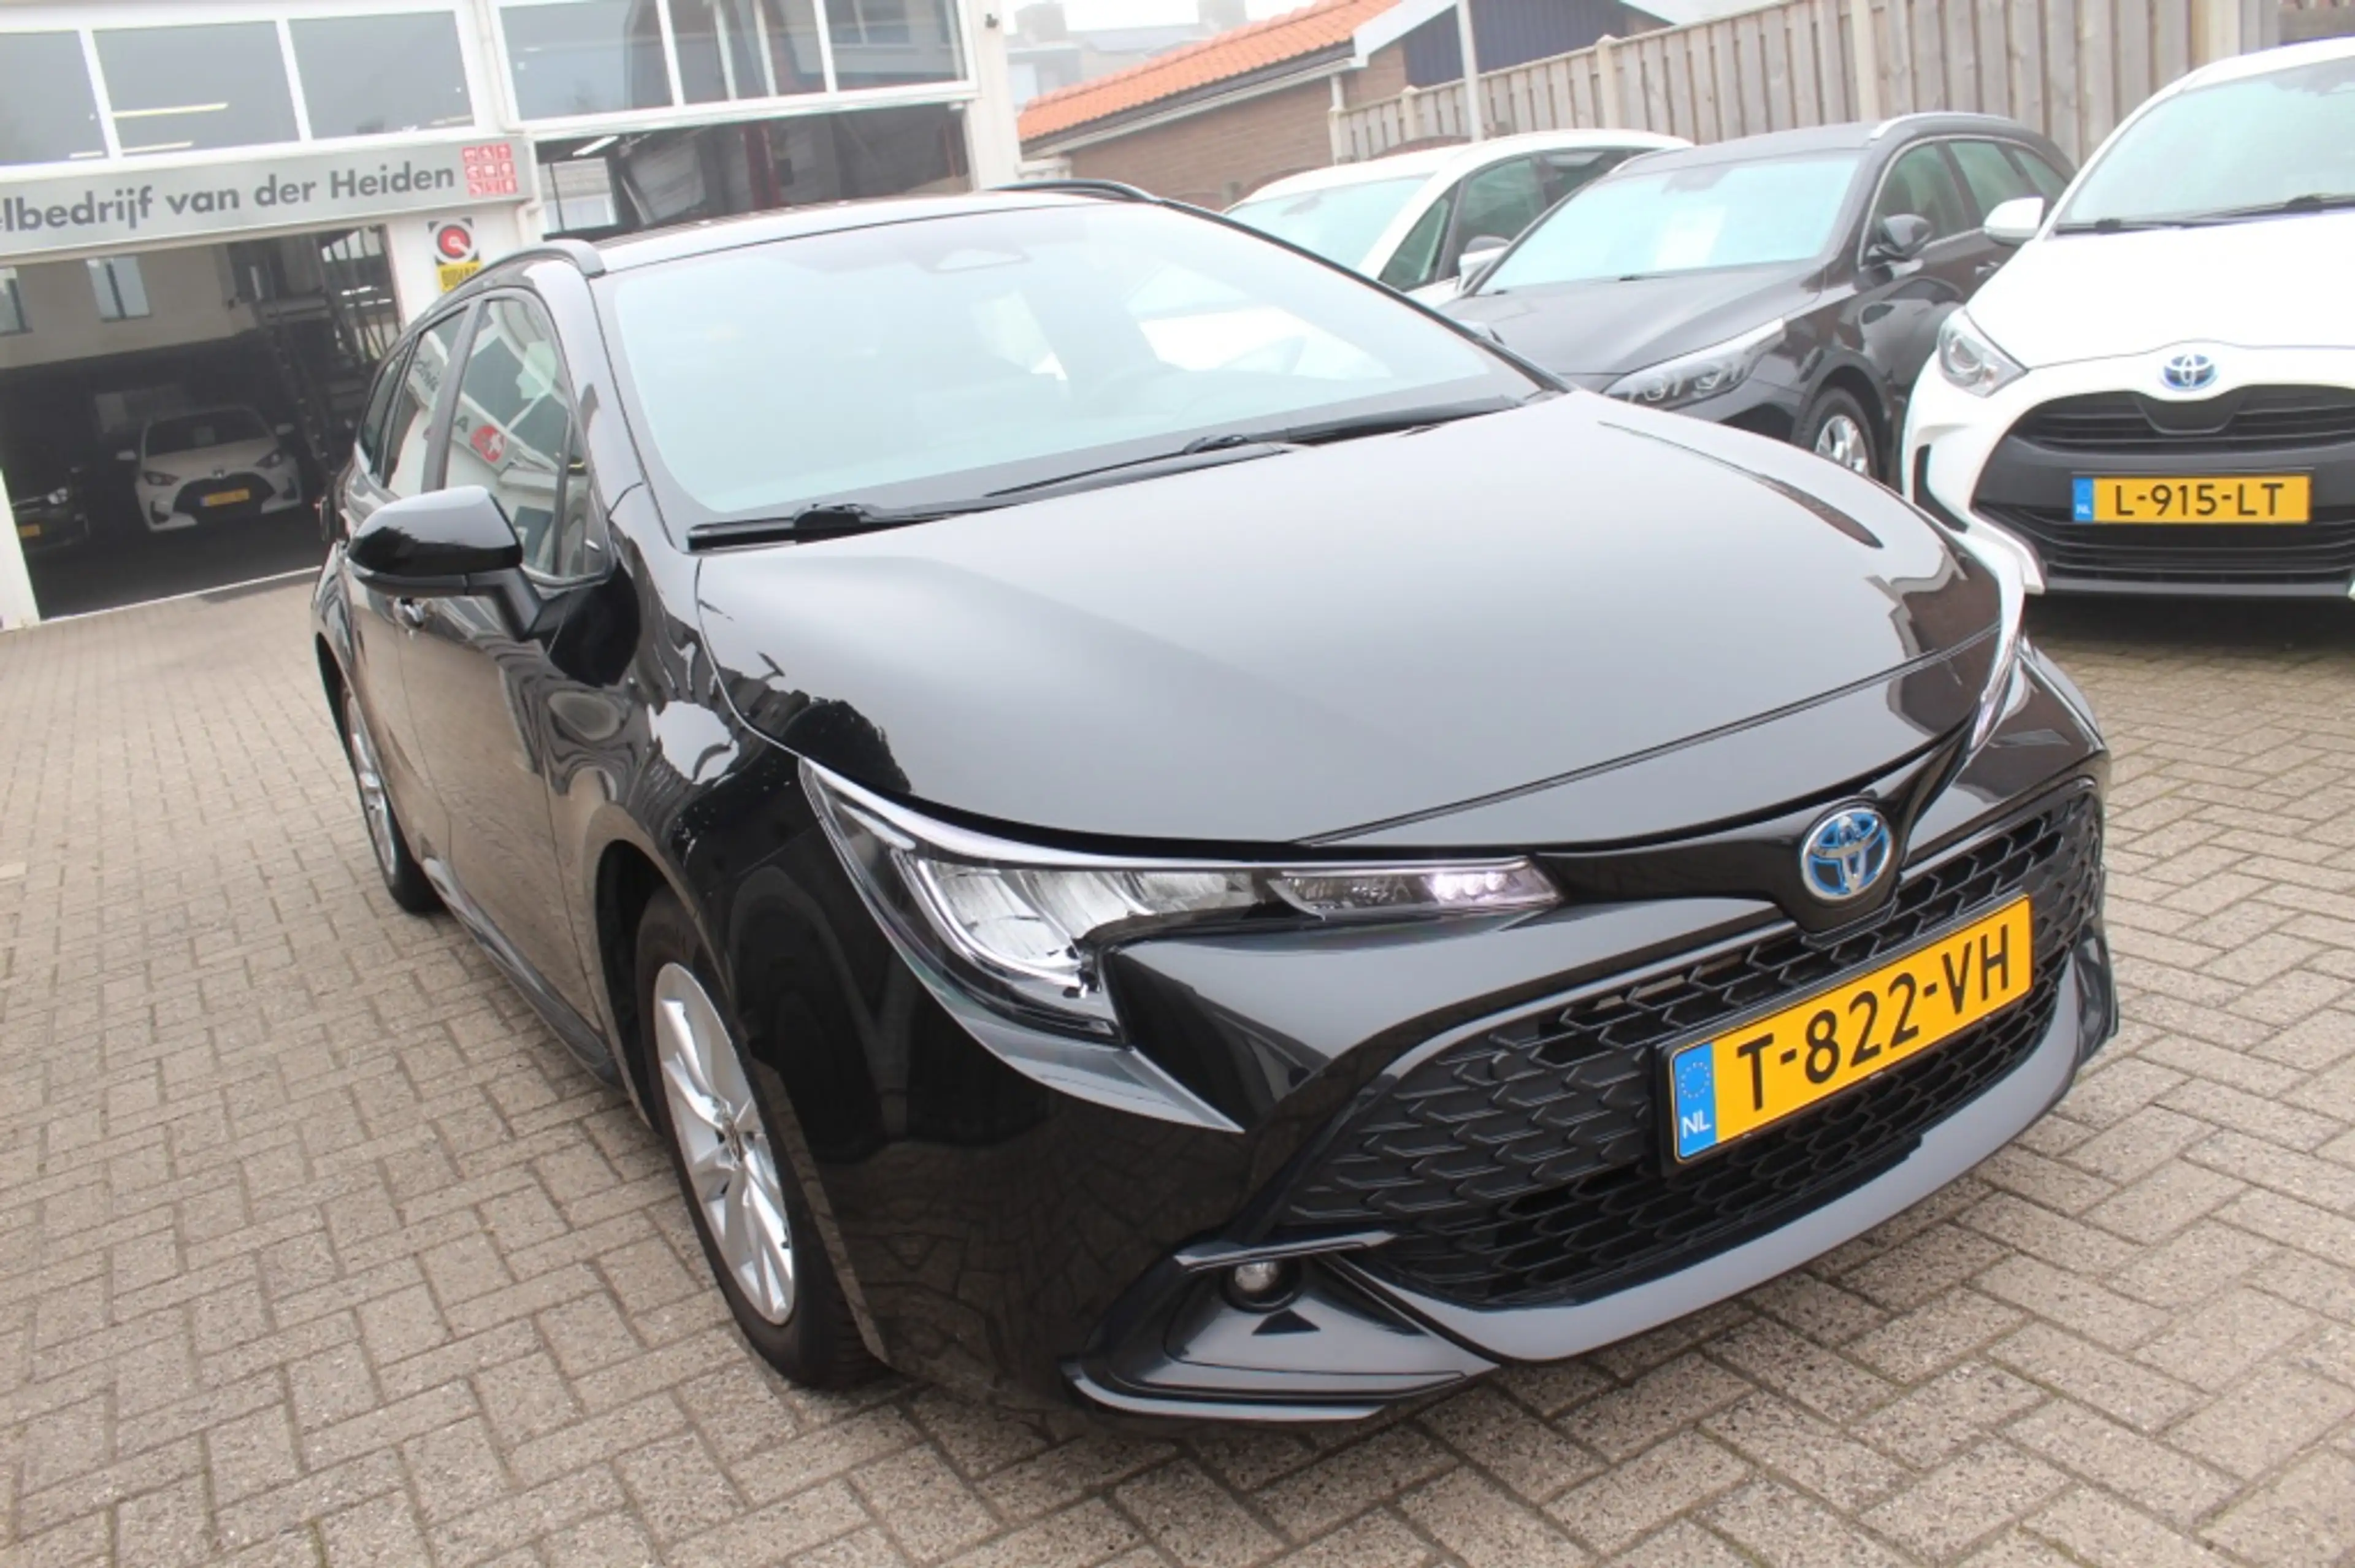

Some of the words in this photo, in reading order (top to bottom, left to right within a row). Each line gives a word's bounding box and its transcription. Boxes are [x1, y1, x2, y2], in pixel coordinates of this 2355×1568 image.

[0, 185, 153, 232] lbedrijf
[166, 188, 240, 215] van
[254, 174, 316, 207] der
[329, 161, 454, 199] Heiden
[2115, 483, 2284, 516] L-915-LT
[1682, 1109, 1711, 1139] NL
[1736, 924, 2009, 1112] T-822-VH
